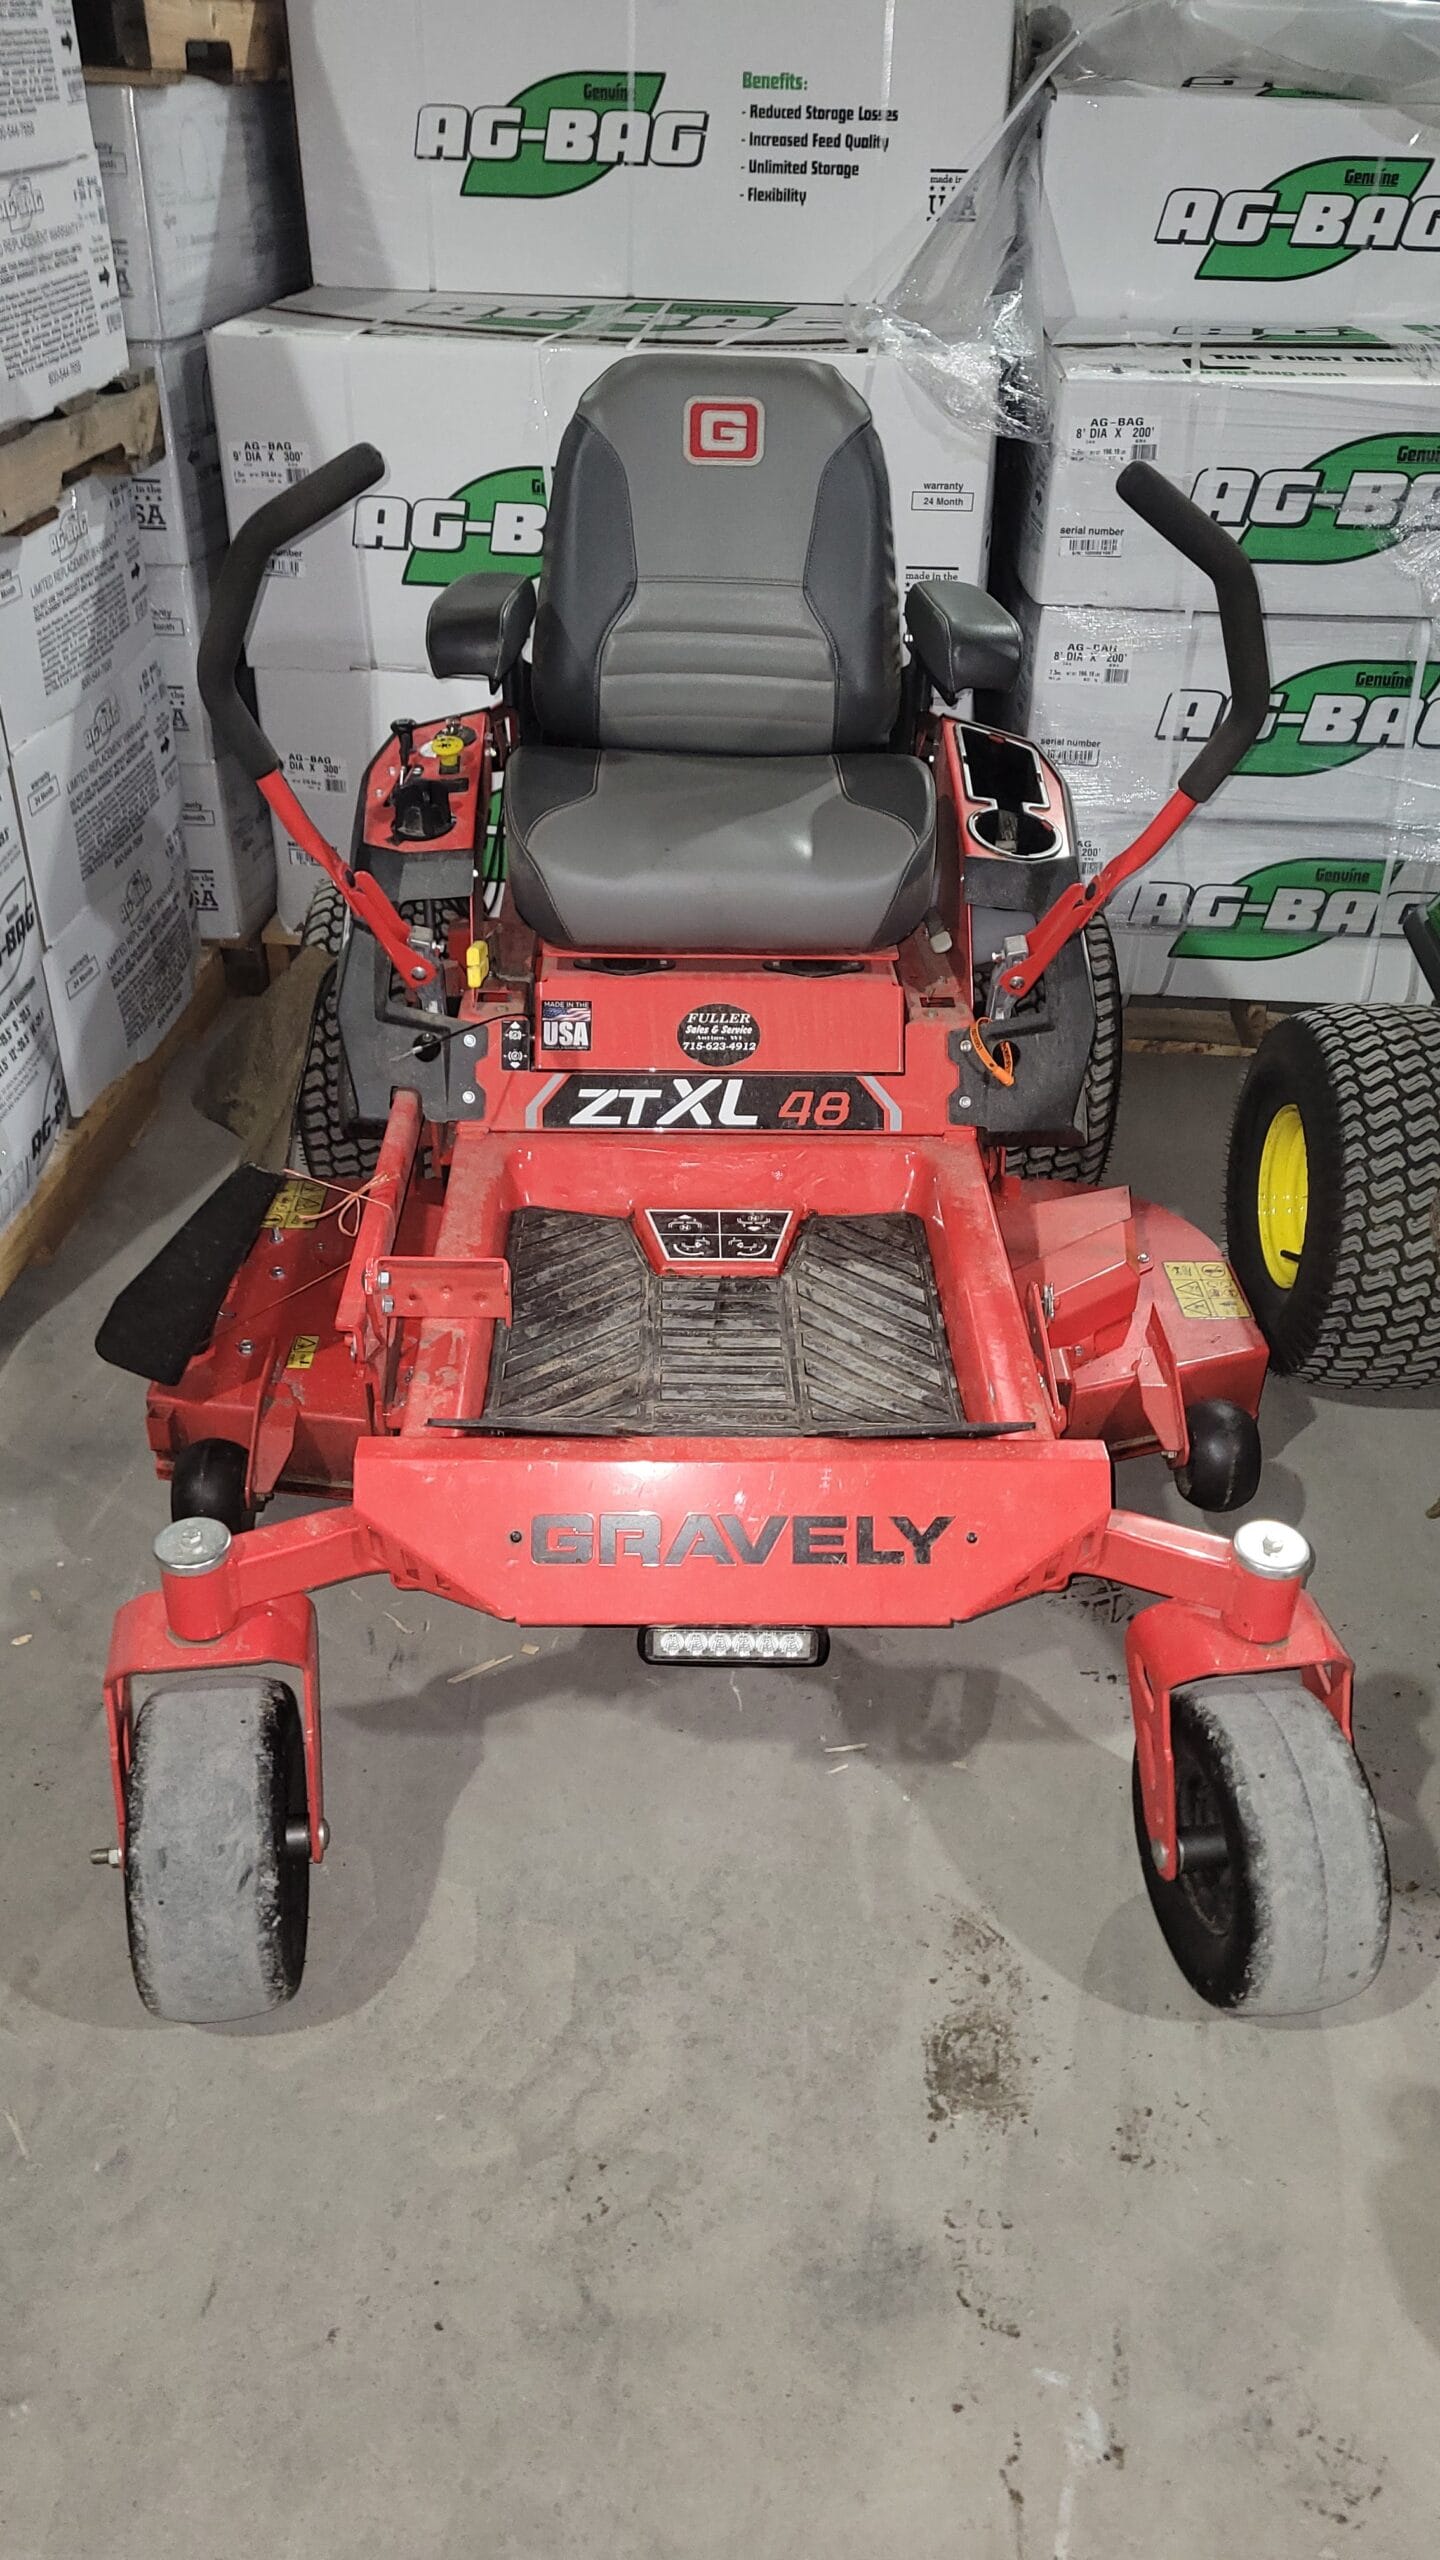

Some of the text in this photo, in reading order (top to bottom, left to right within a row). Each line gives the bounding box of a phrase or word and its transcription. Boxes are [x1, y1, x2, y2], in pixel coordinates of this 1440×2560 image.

[742, 71, 808, 91] Benefits:
[750, 104, 802, 120] Reduced
[805, 105, 854, 124] Storage
[414, 103, 709, 167] AG-BAG
[749, 132, 808, 148] Increased
[812, 133, 841, 148] Feed
[845, 134, 889, 152] Quality
[749, 160, 807, 175] Unlimited
[811, 161, 859, 179] Storage
[747, 187, 807, 206] Flexibility
[1090, 417, 1144, 427] AG-BAG
[1076, 427, 1155, 439] 8' DIA X 200'
[244, 441, 292, 450] AG-BAG
[246, 452, 261, 462] DIA
[268, 452, 275, 462] X
[284, 452, 303, 462] 300'
[923, 482, 964, 492] warranty
[923, 497, 964, 506] 24 Month
[1060, 526, 1124, 536] serial number
[905, 571, 958, 581] made in the
[1040, 738, 1101, 748] serial number
[289, 753, 331, 764] AG-BAG
[290, 761, 304, 771] DIA
[1316, 868, 1370, 885] Genuine
[687, 1013, 751, 1024] FULLER
[543, 1022, 589, 1046] USA
[685, 1025, 753, 1034] Sales & Service
[682, 1042, 757, 1051] 715-623-4912
[778, 1091, 851, 1126] 48
[531, 1513, 956, 1567] GRAVELY
